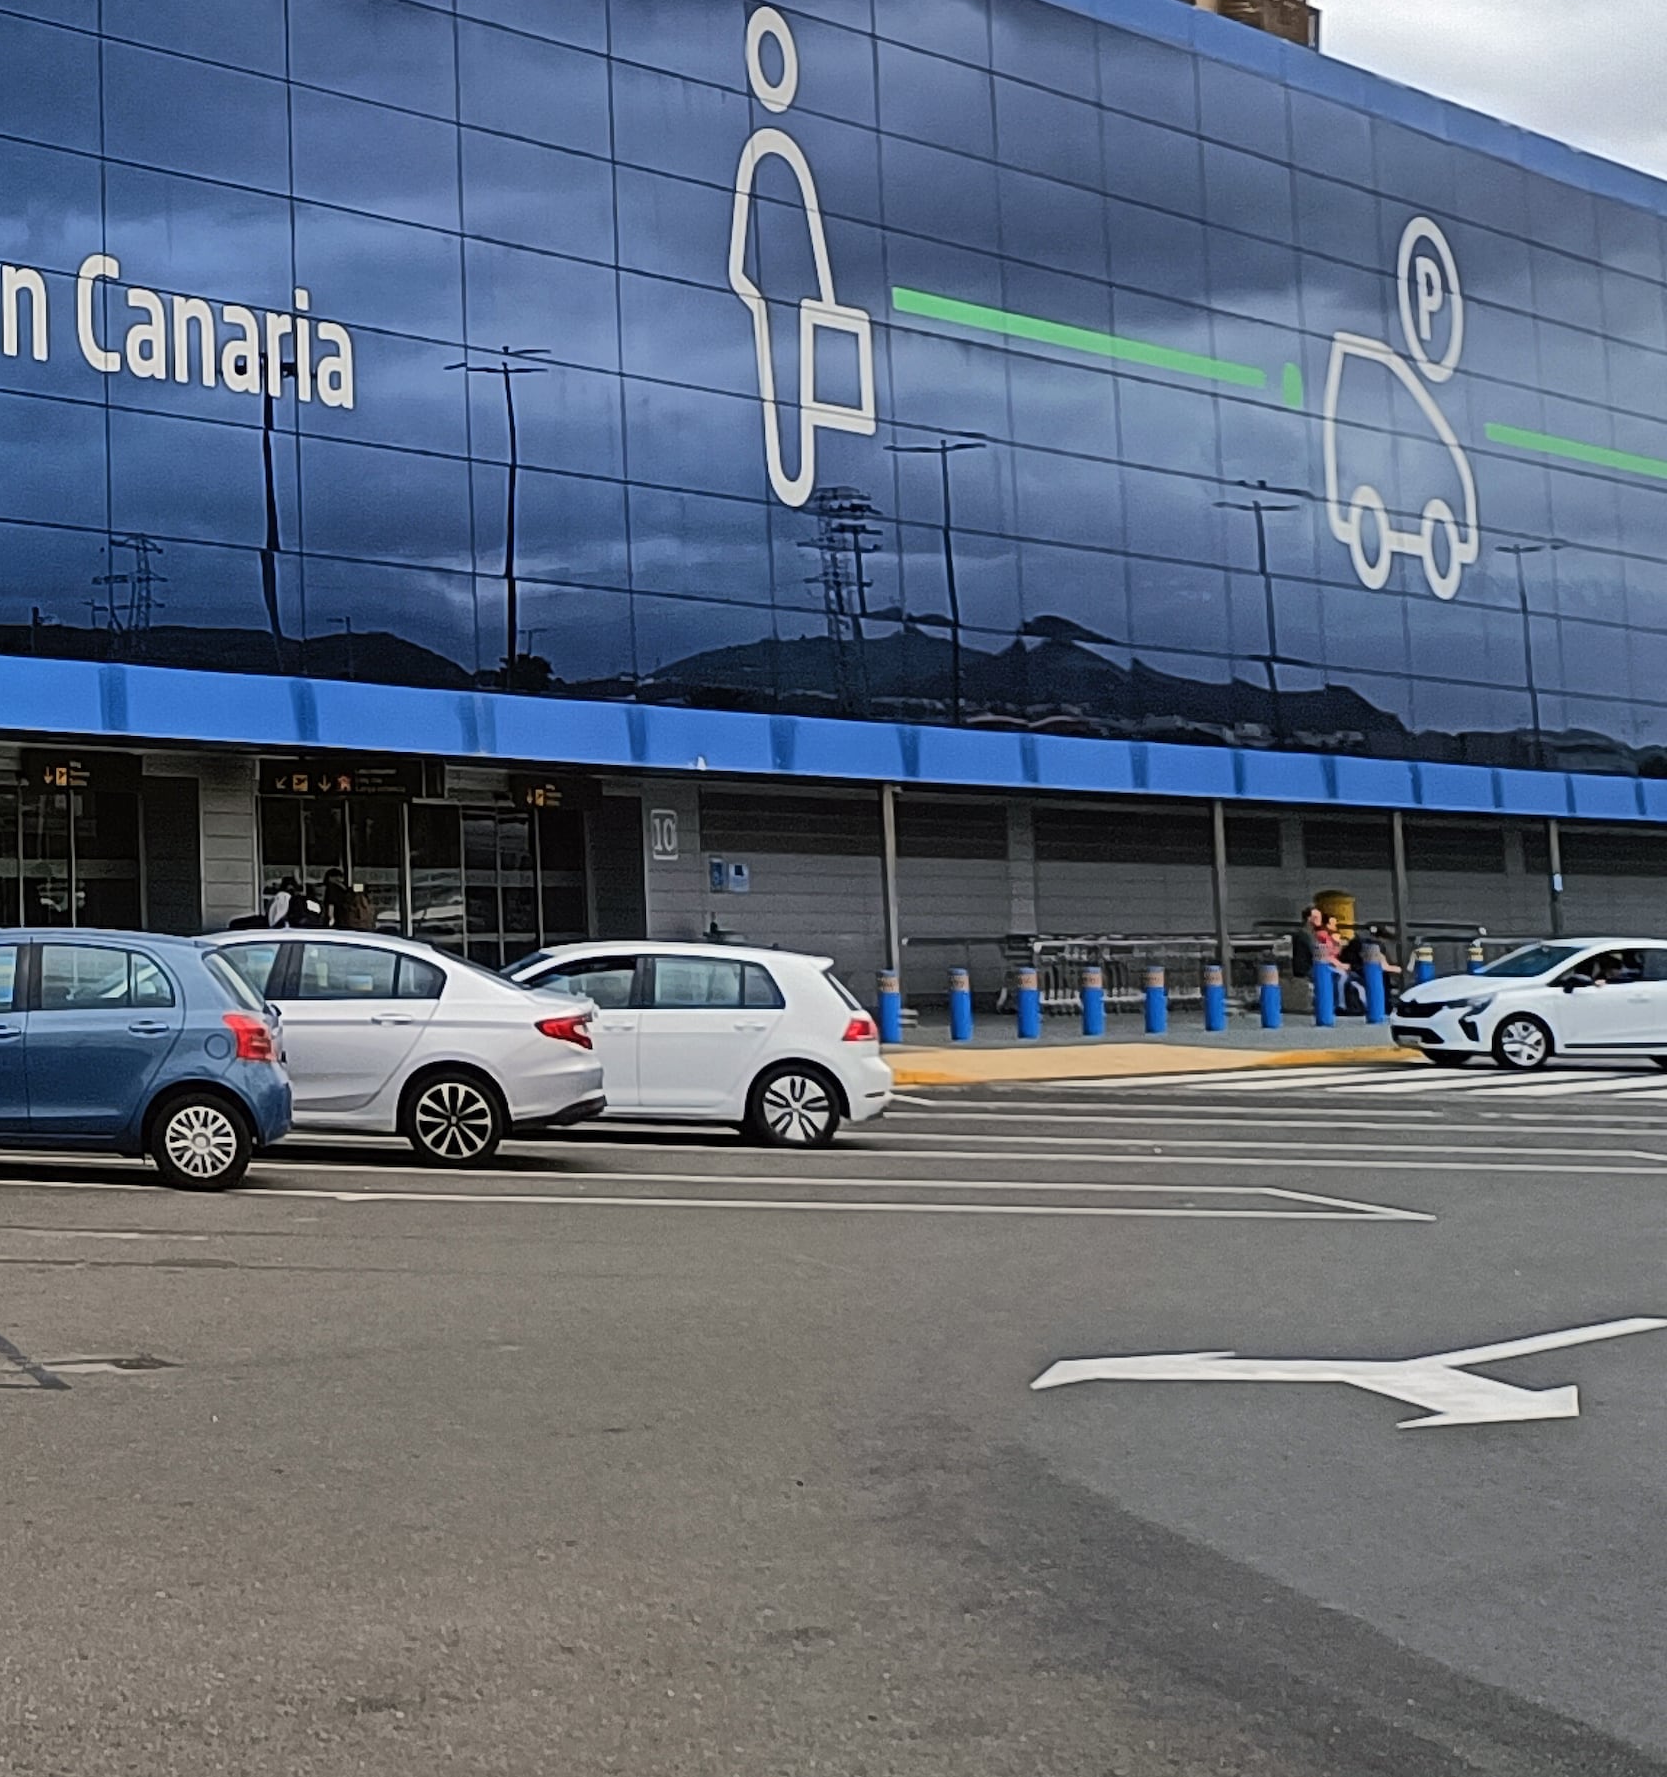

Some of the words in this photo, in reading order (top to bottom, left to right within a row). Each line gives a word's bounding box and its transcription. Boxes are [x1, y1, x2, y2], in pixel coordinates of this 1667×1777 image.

[76, 253, 355, 411] Canaria
[1415, 255, 1443, 341] P
[652, 818, 676, 852] 10
